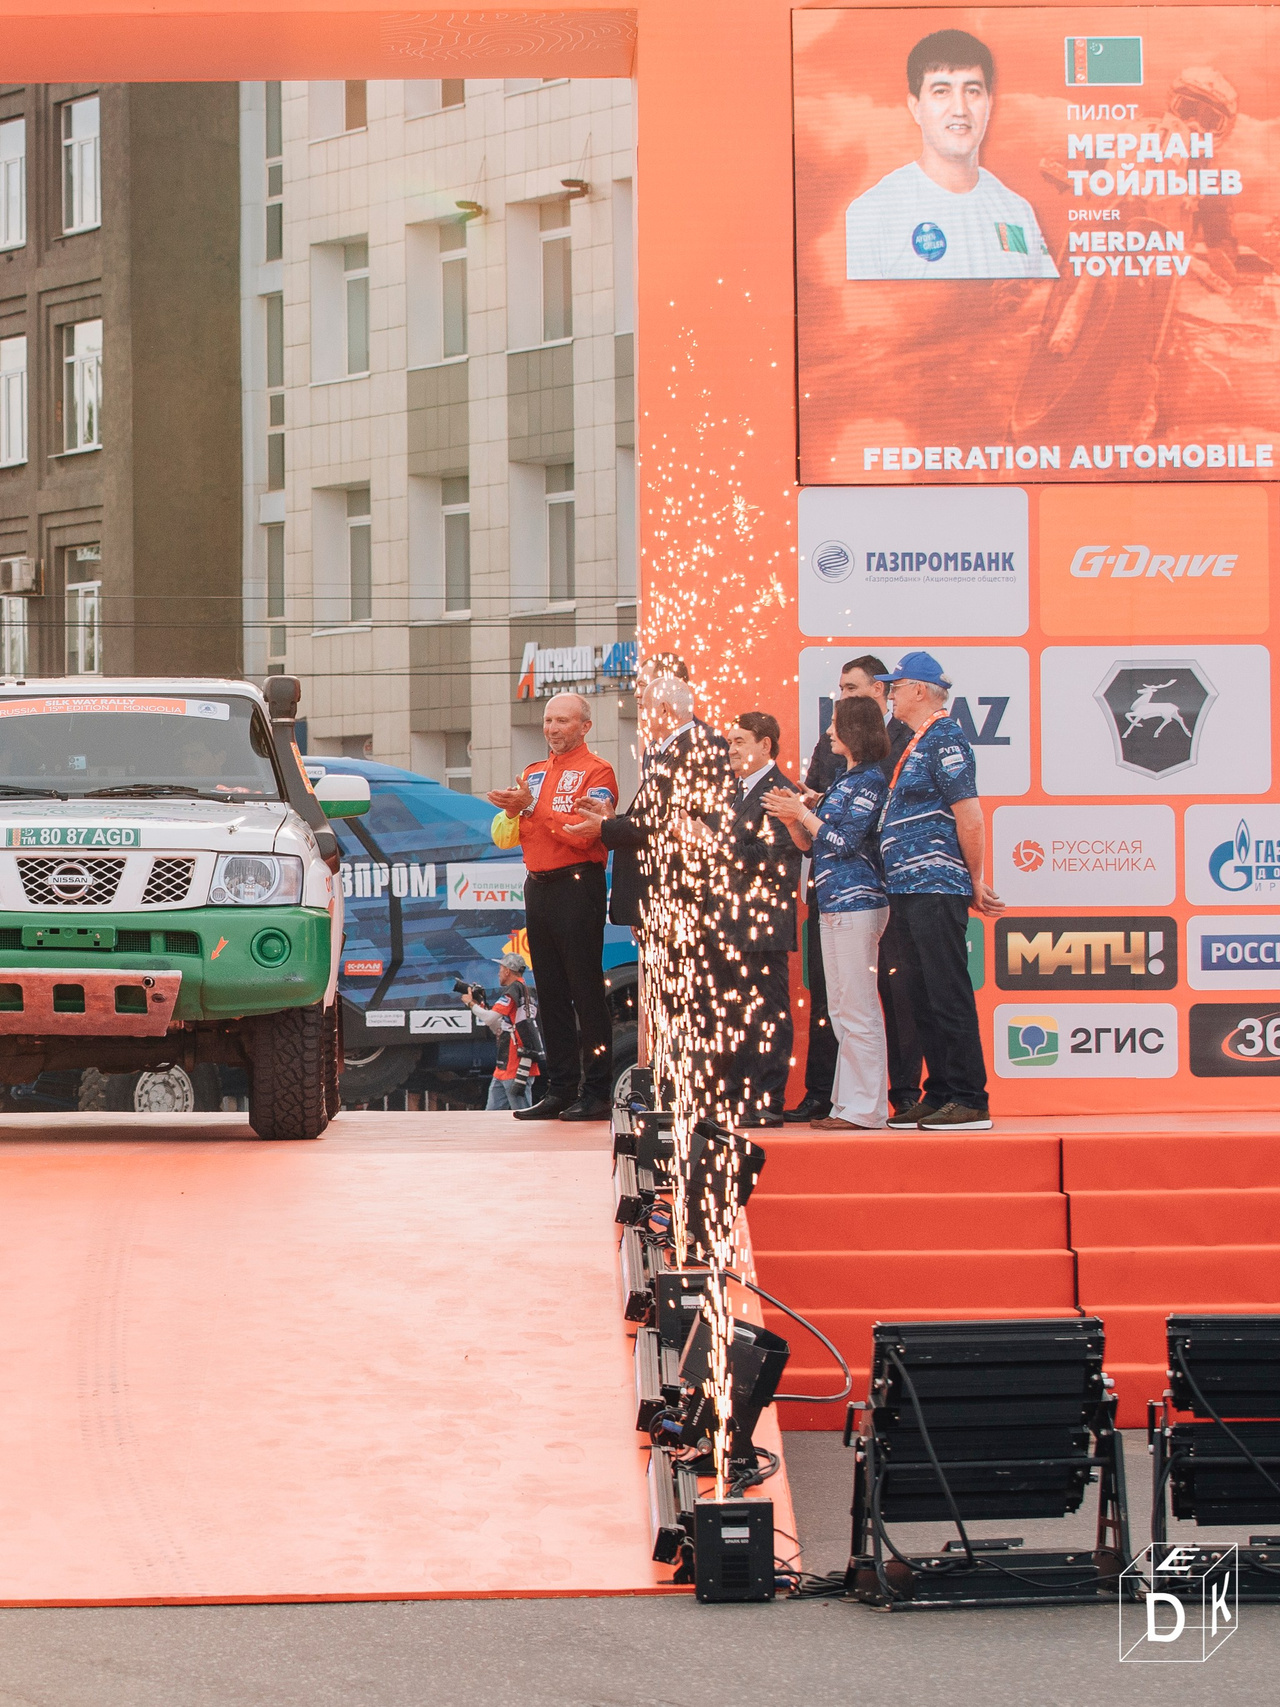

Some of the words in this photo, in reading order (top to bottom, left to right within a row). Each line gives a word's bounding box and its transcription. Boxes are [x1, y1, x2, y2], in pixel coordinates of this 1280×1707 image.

[1066, 104, 1139, 121] ПИЛОТ
[1067, 132, 1215, 164] МЕРДАН
[1067, 164, 1244, 197] ТОЙЛЫЕВ
[1067, 209, 1121, 222] DRIVER
[1068, 231, 1185, 252] MERDAN
[1069, 254, 1192, 278] TOYLYEV
[863, 445, 1061, 471] FEDERATION
[1069, 443, 1274, 470] AUTOMOBILE
[865, 551, 1016, 573] ГАЗПРОМБАНК
[0, 706, 38, 717] RUSSIA
[66, 703, 110, 712] EDITION
[123, 704, 183, 714] MONGOLIA
[73, 698, 96, 706] WAY
[100, 698, 136, 706] RALLY
[552, 795, 574, 805] SILK
[552, 804, 574, 813] WAY
[21, 836, 36, 845] TM
[39, 828, 62, 846] 80
[66, 828, 88, 845] 87
[91, 828, 136, 846] AGD
[1052, 840, 1143, 855] РУССКАЯ
[1052, 857, 1157, 872] МЕХАНИКА
[52, 876, 89, 884] NISSAN
[1007, 930, 1166, 976] МАТЧ!
[1070, 1027, 1166, 1055] 2ГИС
